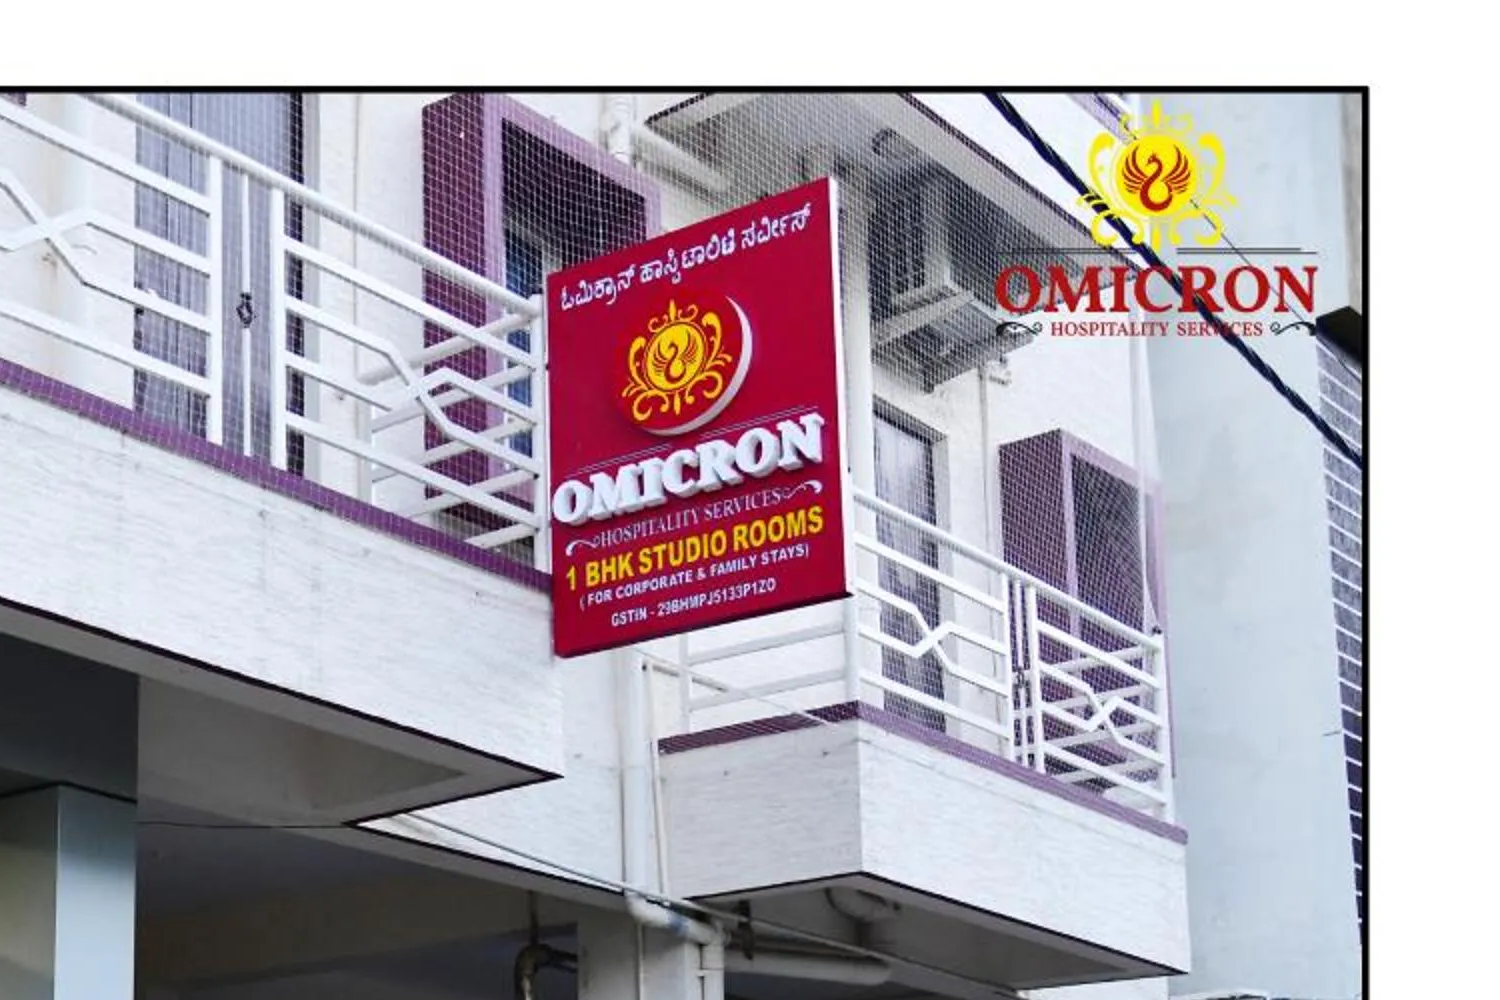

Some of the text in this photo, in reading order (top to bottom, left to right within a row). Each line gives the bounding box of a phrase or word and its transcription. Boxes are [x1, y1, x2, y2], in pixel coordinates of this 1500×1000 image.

[553, 413, 824, 525] OMICRON
[601, 487, 782, 547] HOSPITALITY SERVICES
[566, 505, 824, 590] 1 BHK STUDIO ROOMS
[615, 571, 693, 599] CORPORATE
[697, 566, 707, 580] &
[710, 555, 756, 577] FAMILY
[611, 607, 647, 628] GSTIN
